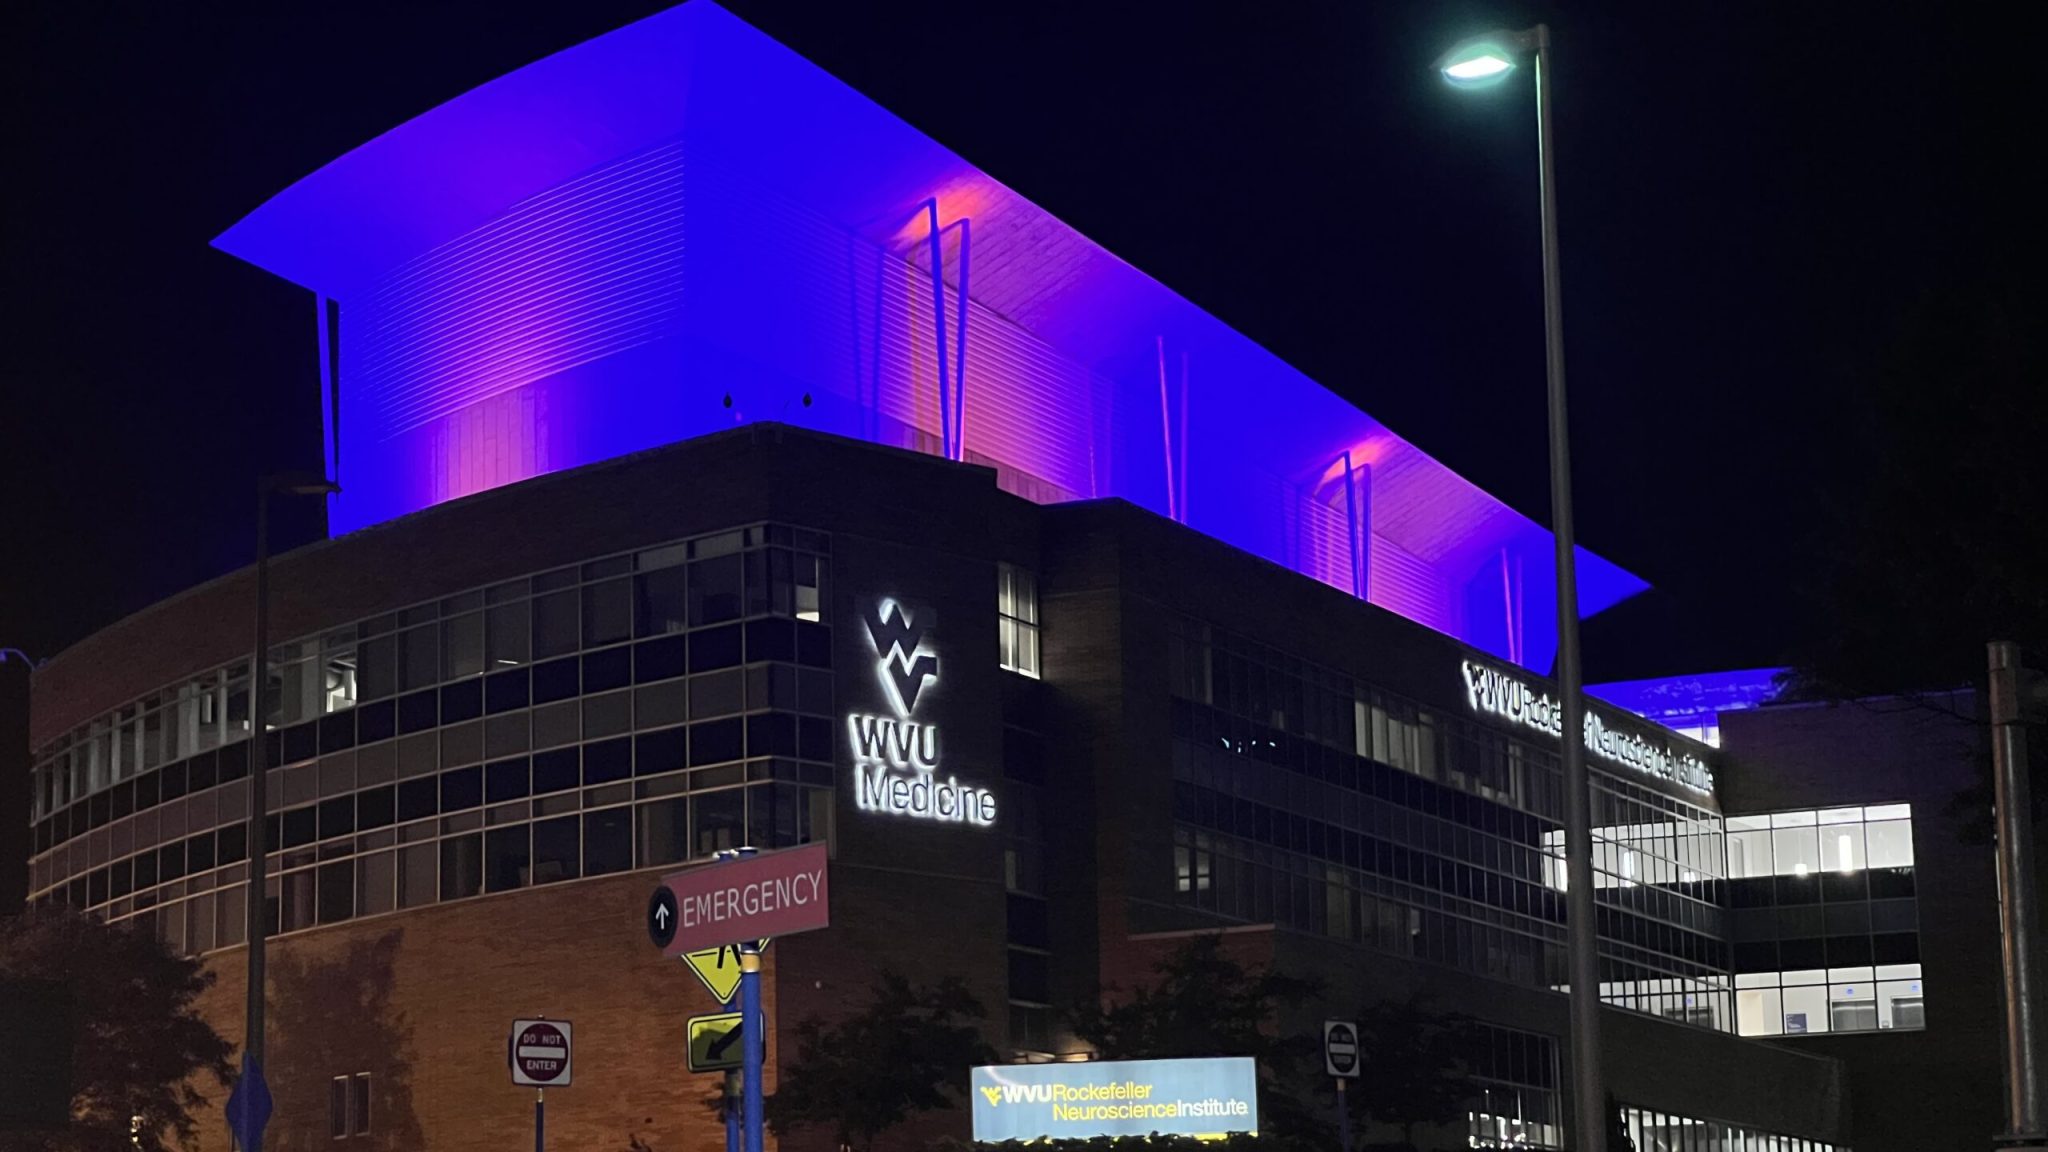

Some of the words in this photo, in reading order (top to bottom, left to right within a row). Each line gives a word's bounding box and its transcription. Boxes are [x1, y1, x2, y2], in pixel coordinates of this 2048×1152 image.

[849, 714, 940, 768] WVU
[856, 764, 998, 824] Medicine
[683, 869, 822, 928] EMERGENCY
[523, 1034, 536, 1044] DO
[542, 1034, 561, 1045] NOT
[526, 1060, 557, 1070] ENTER
